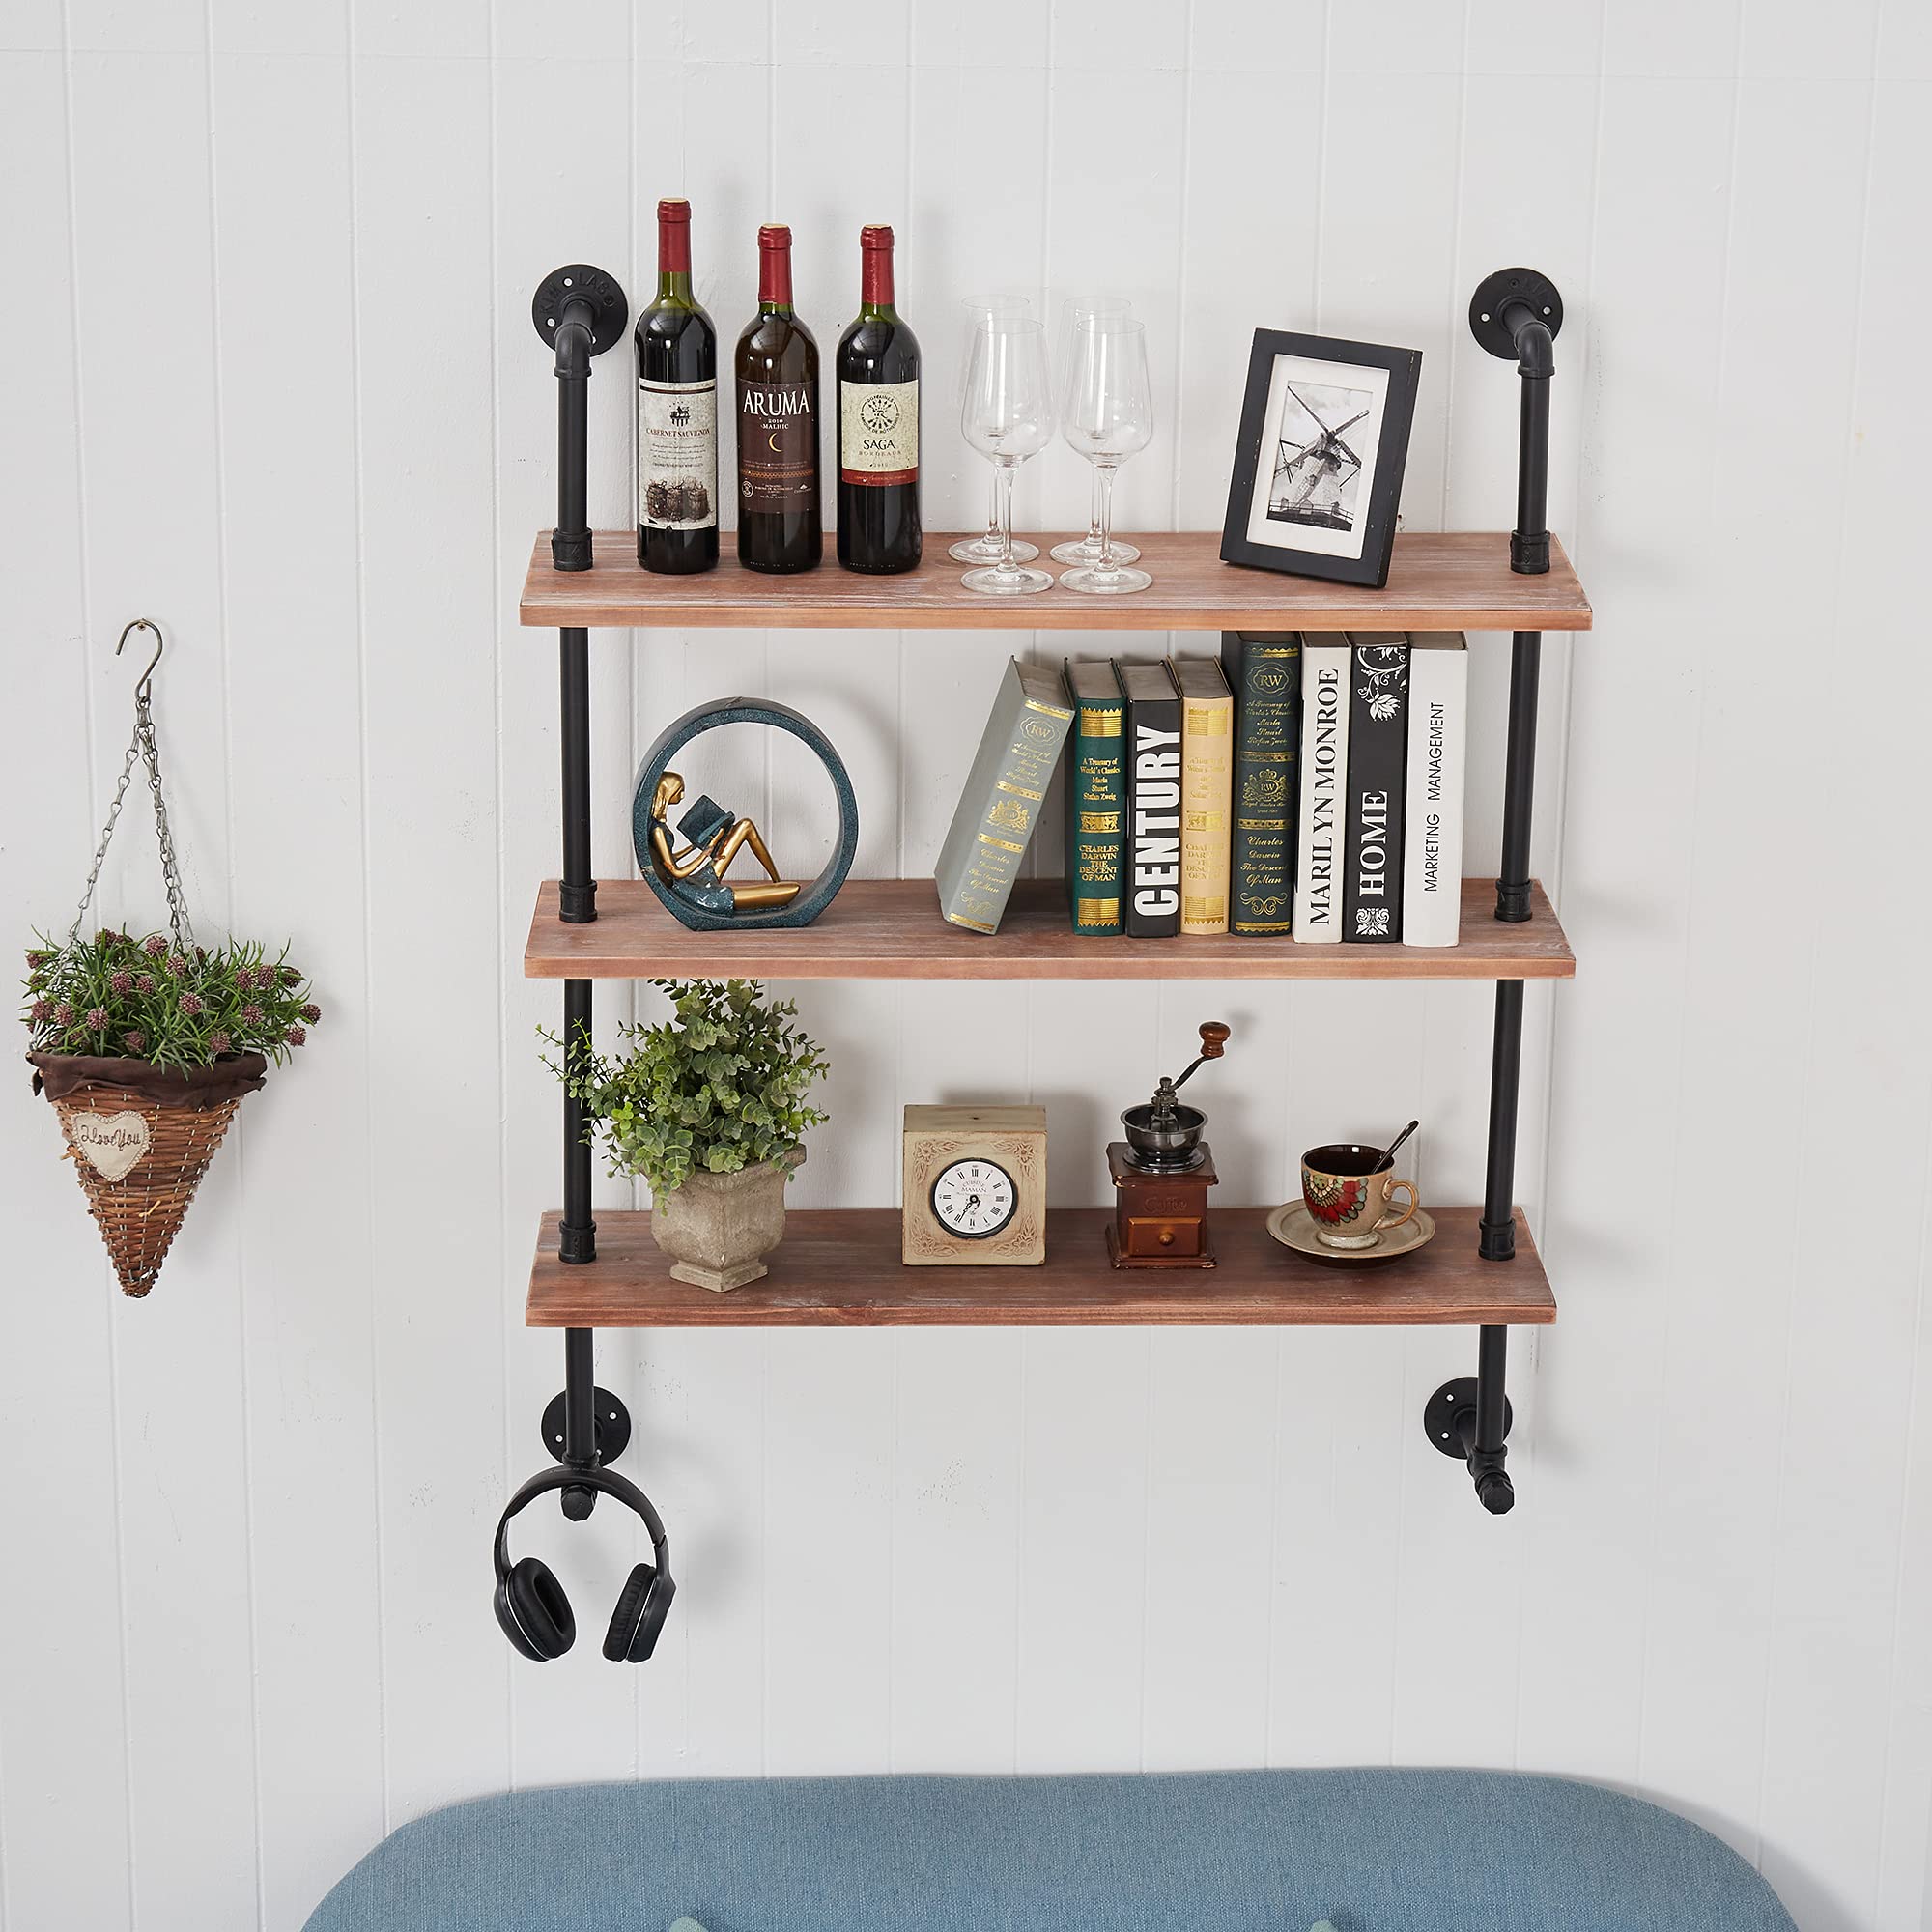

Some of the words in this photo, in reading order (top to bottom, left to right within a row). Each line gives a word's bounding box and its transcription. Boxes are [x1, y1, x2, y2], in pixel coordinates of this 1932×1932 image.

[743, 389, 810, 416] ARUMA
[863, 439, 896, 450] SAGA
[1260, 674, 1283, 688] RW
[1030, 724, 1051, 738] RW
[1314, 668, 1340, 791] MONROE
[1427, 702, 1445, 801] MANAGEMENT
[1134, 724, 1181, 917] CENTURY
[1078, 844, 1120, 853] CHARLES
[1247, 835, 1284, 846] Charles
[1248, 849, 1281, 859] Darwin
[1358, 790, 1388, 897] HOME
[1424, 813, 1440, 892] MARKETING
[1309, 796, 1335, 926] MARILYN
